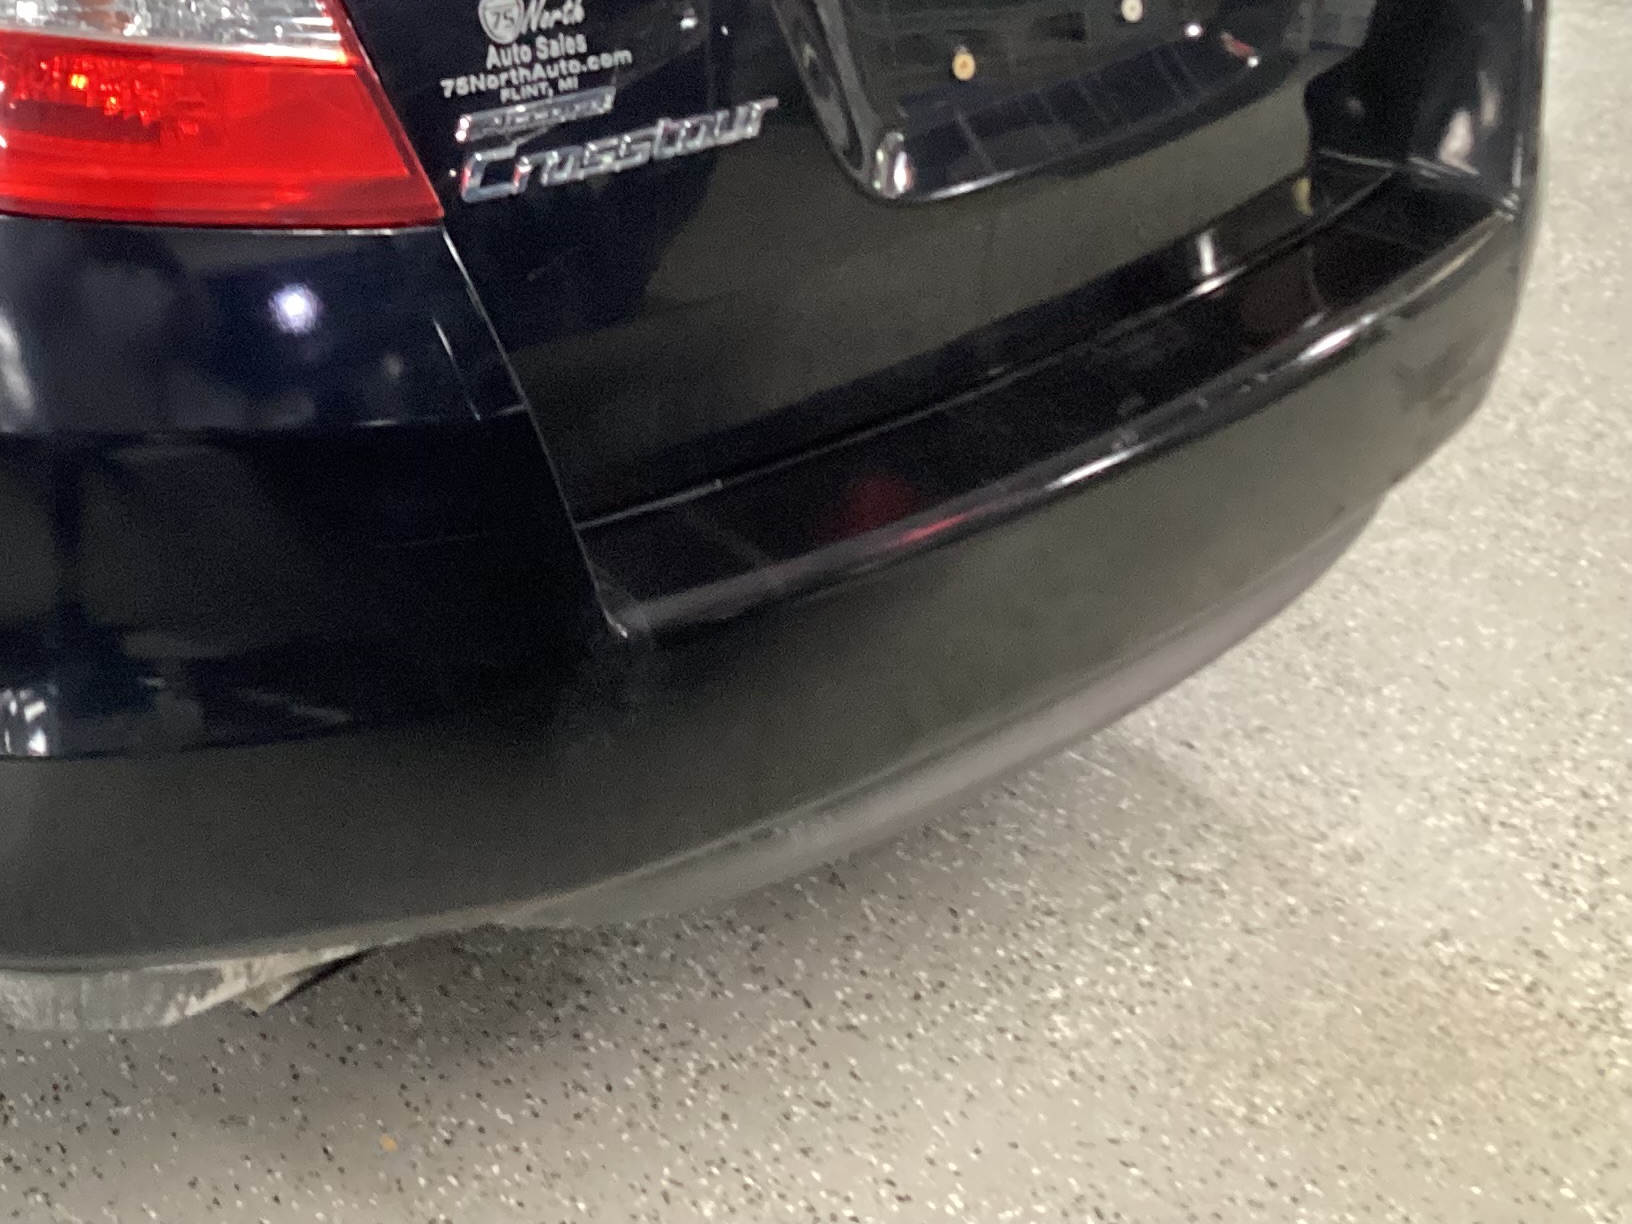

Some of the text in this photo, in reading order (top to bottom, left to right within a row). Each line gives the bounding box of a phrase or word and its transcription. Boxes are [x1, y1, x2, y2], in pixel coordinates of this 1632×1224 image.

[491, 10, 516, 29] 75
[486, 32, 588, 70] Auto Sales
[440, 49, 633, 99] 75NorthAuto.com
[499, 75, 580, 105] FLINT, MI
